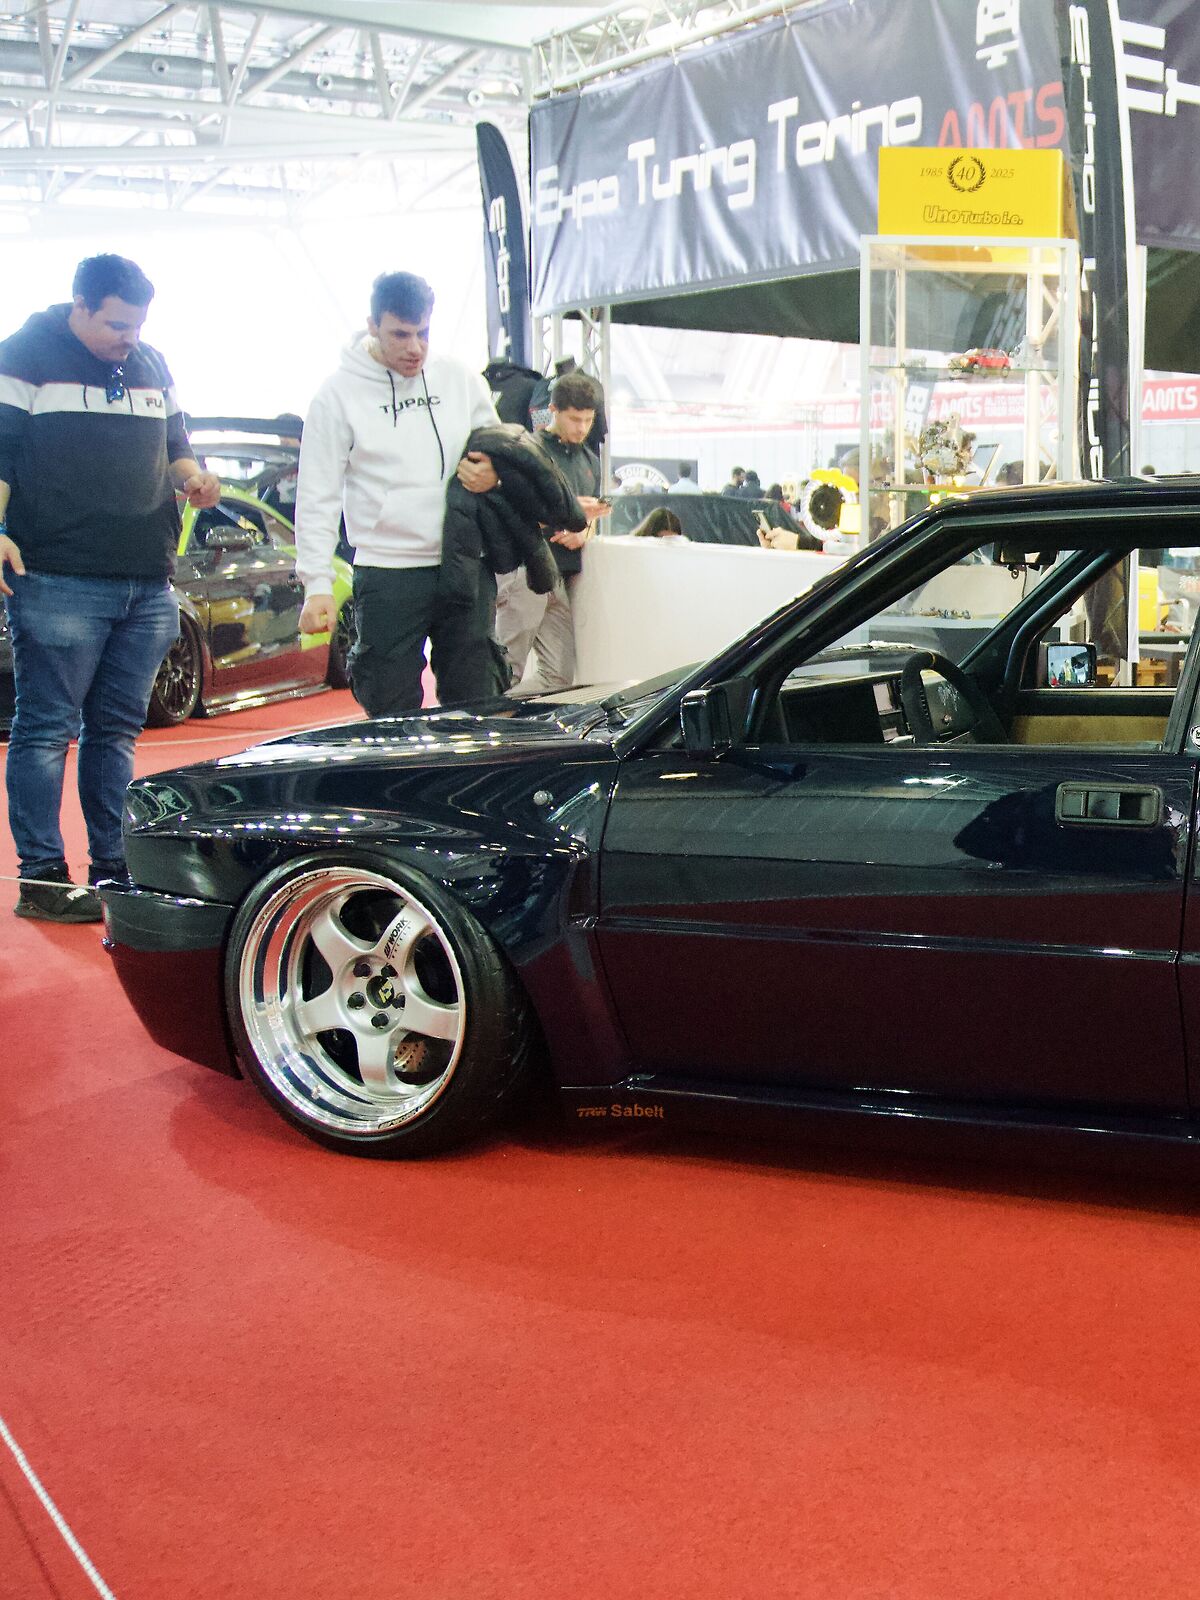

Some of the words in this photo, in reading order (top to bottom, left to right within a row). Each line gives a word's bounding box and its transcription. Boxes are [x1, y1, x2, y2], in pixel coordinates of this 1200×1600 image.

[938, 81, 1065, 149] AMTS
[535, 164, 619, 230] Expo
[628, 138, 756, 209] Tuning
[768, 97, 922, 172] Torino
[920, 168, 943, 177] 1985
[957, 166, 976, 181] 40
[990, 168, 1014, 178] 2025
[379, 395, 441, 414] TUPAC
[1142, 386, 1199, 413] AMTS
[610, 1103, 665, 1119] Sabelt
